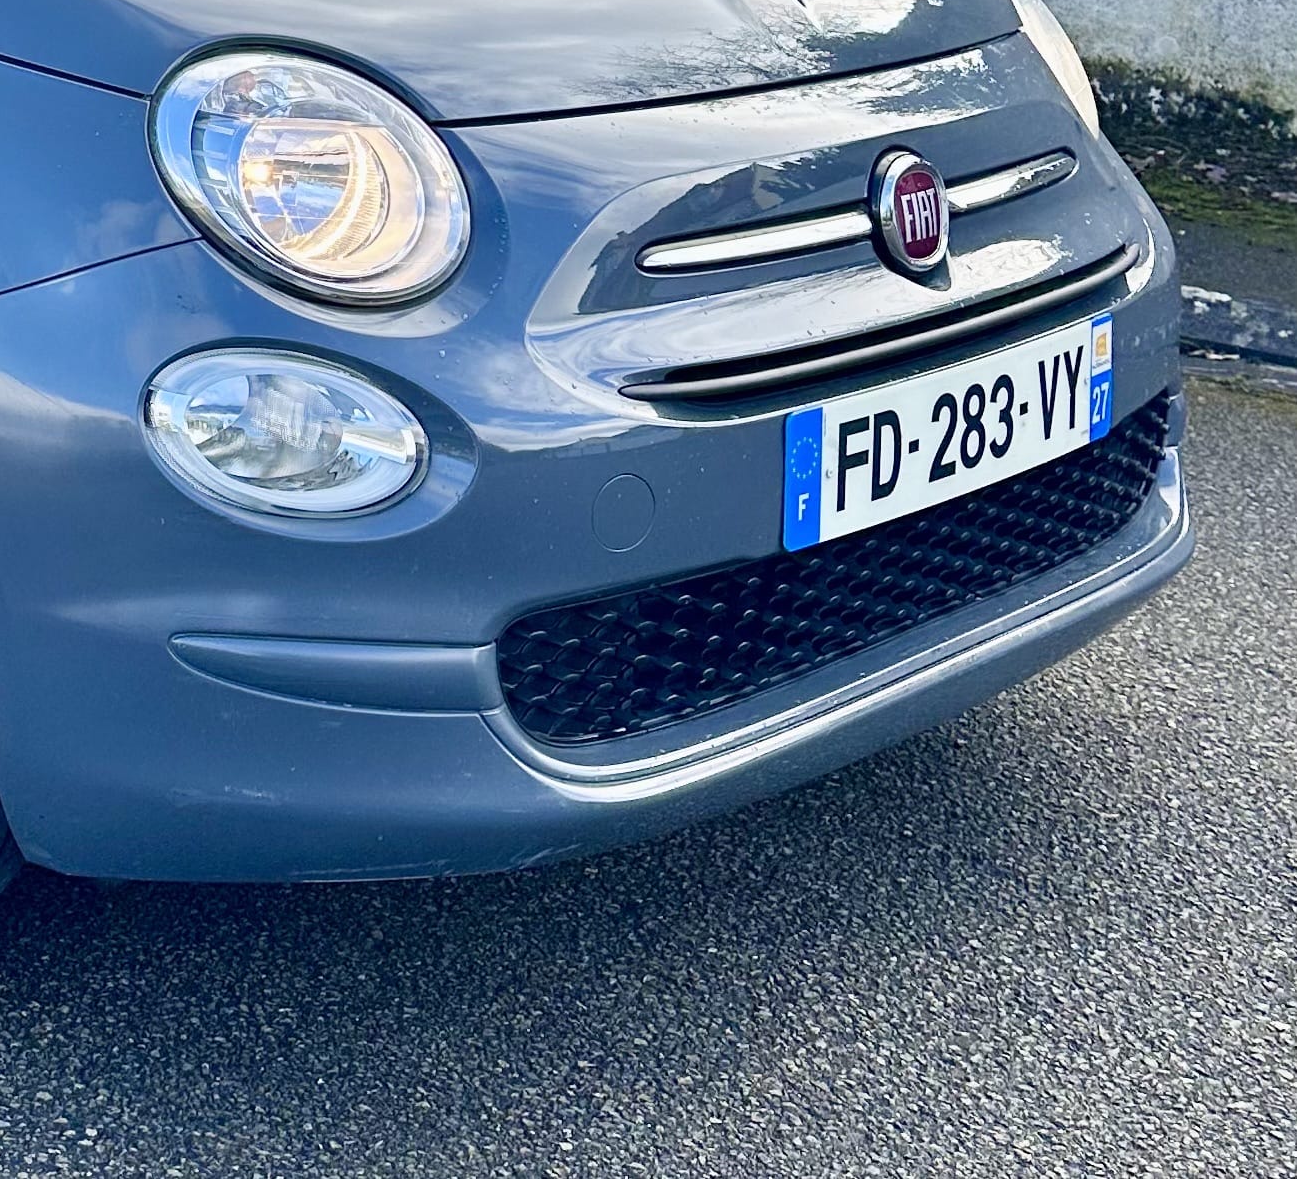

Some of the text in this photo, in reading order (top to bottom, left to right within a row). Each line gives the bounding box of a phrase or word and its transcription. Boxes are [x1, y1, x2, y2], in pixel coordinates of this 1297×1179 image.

[900, 187, 937, 244] FIAT
[1092, 381, 1110, 425] 27
[836, 345, 1084, 512] FD-283-VY
[798, 492, 810, 521] F
